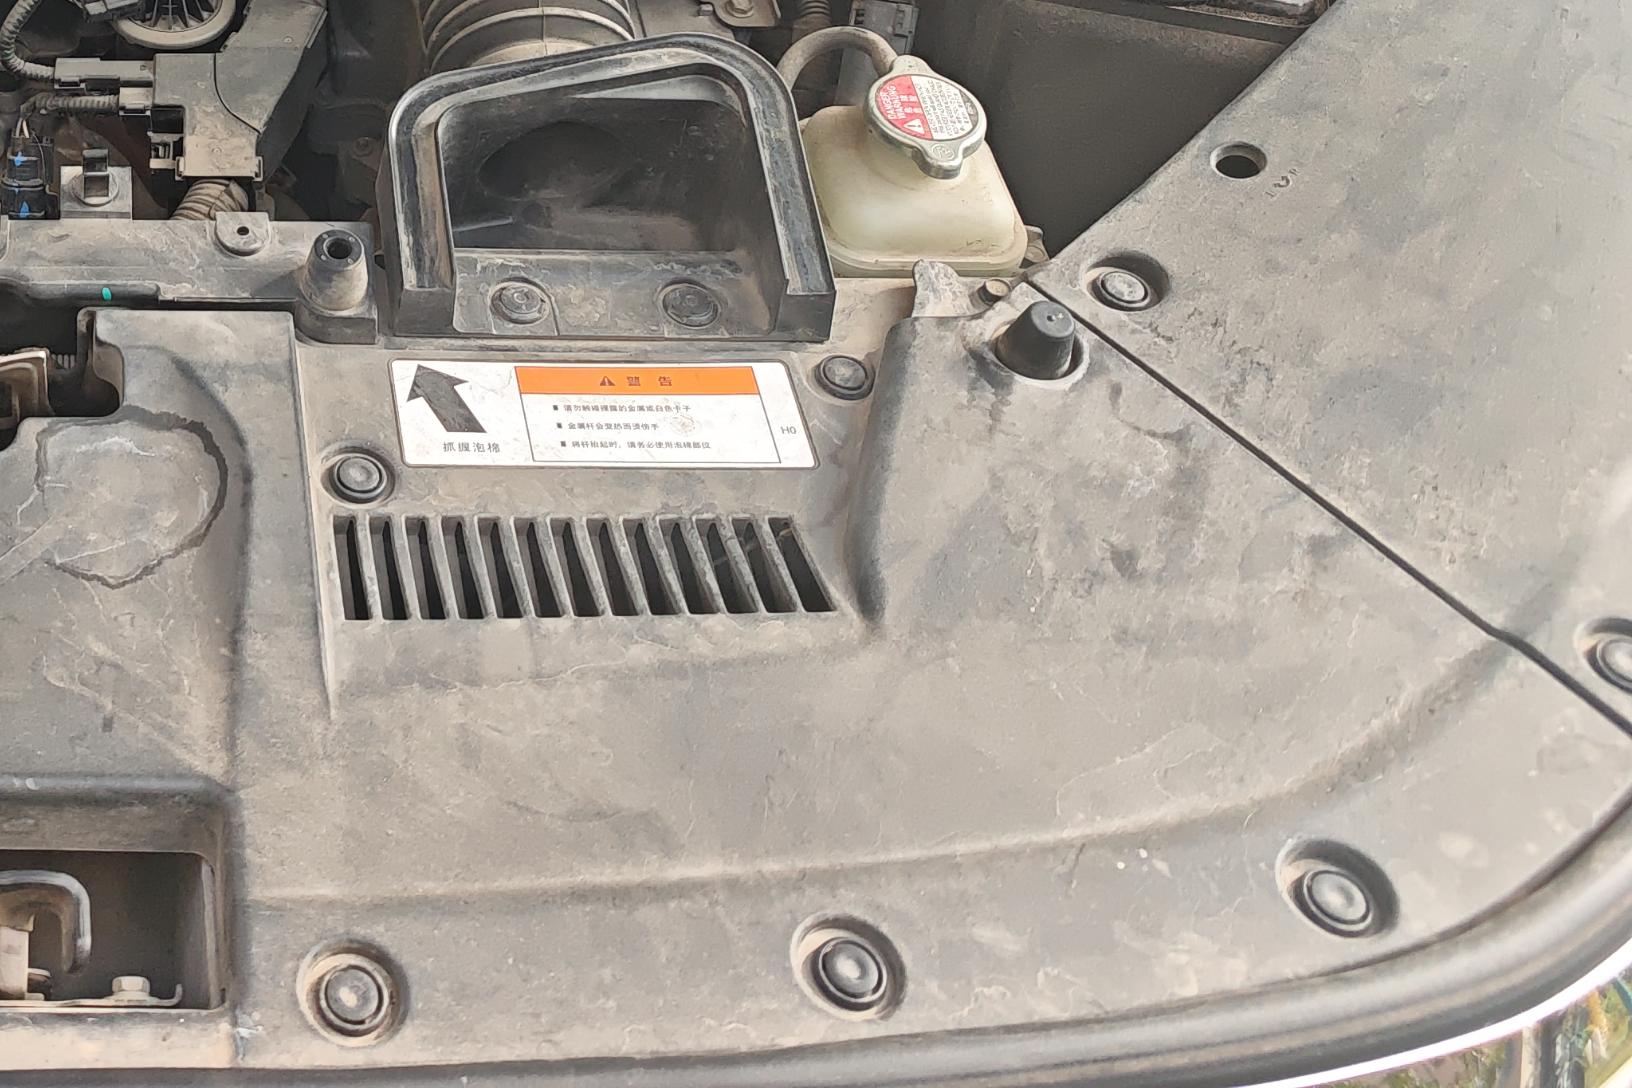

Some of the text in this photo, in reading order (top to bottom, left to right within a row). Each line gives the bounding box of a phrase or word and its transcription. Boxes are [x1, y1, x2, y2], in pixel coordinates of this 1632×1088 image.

[626, 375, 673, 387] 警告
[442, 441, 501, 453] 抓握泡棉
